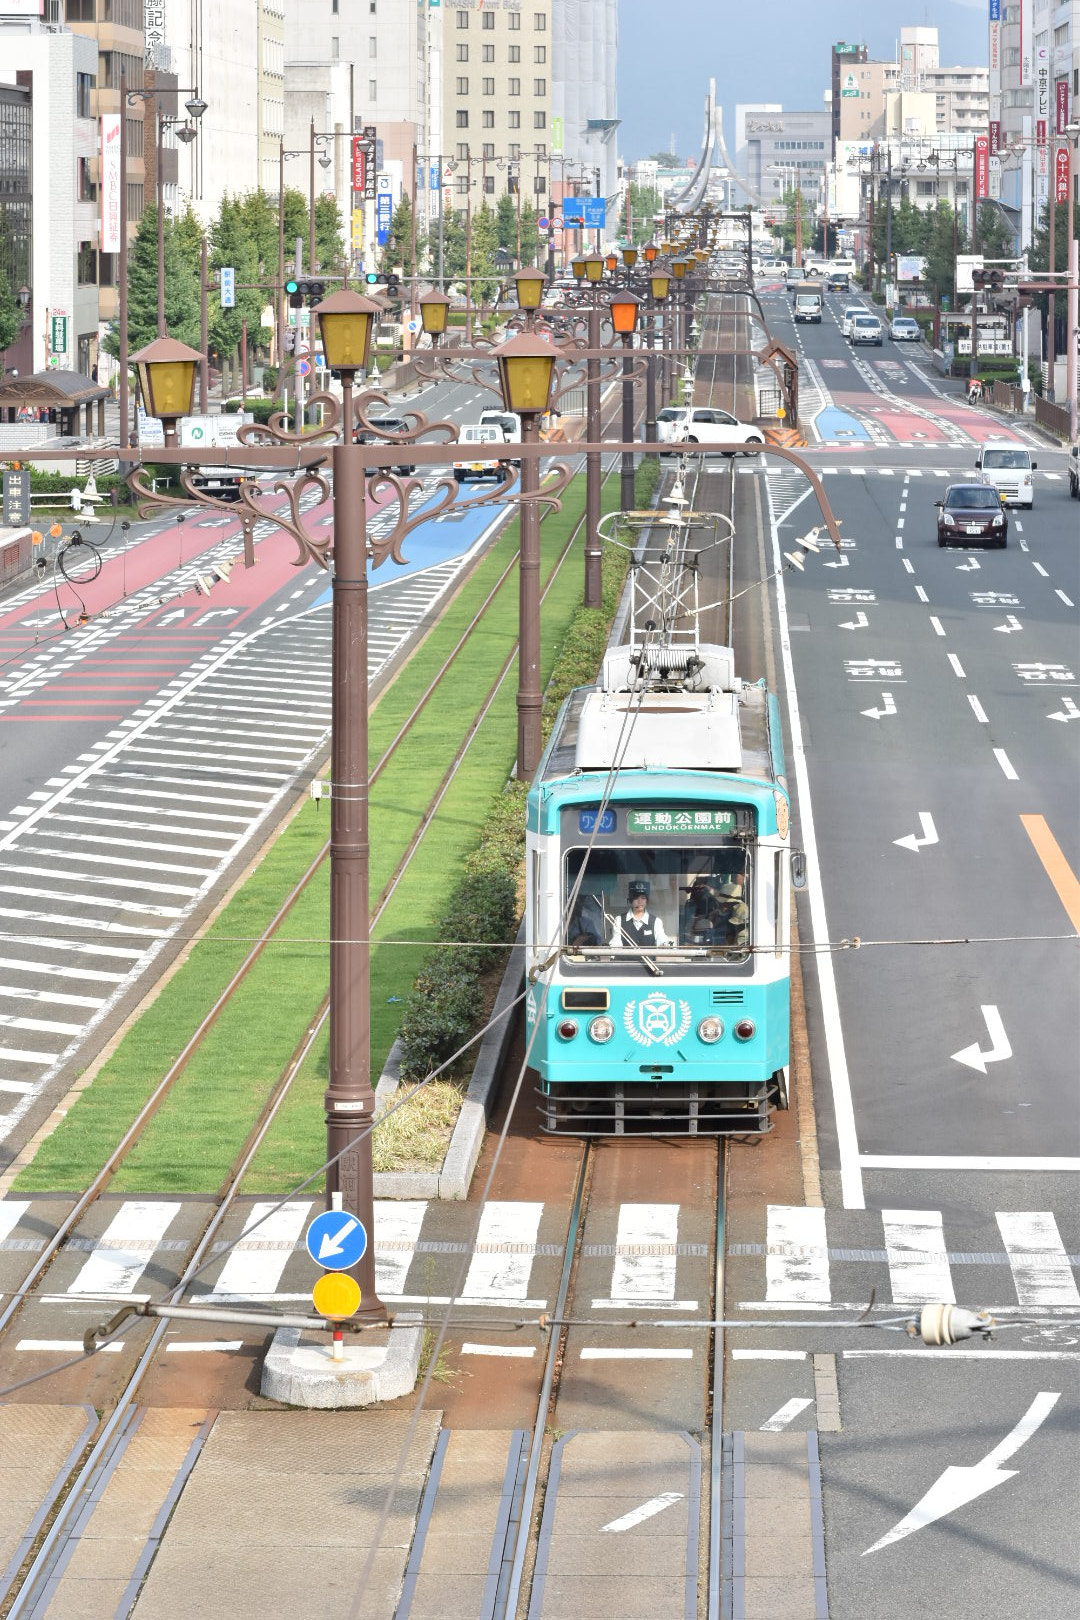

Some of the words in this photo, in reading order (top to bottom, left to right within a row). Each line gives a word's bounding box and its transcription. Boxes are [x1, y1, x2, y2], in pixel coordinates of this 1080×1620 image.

[1038, 68, 1047, 115] 中京テレビ
[1058, 163, 1068, 201] 十六銀行
[109, 161, 118, 241] SMBC日興証券
[379, 196, 391, 231] 第三銀行
[224, 270, 232, 304] 駅前大通
[582, 815, 613, 829] ワンマン
[634, 812, 731, 825] 運動公園前
